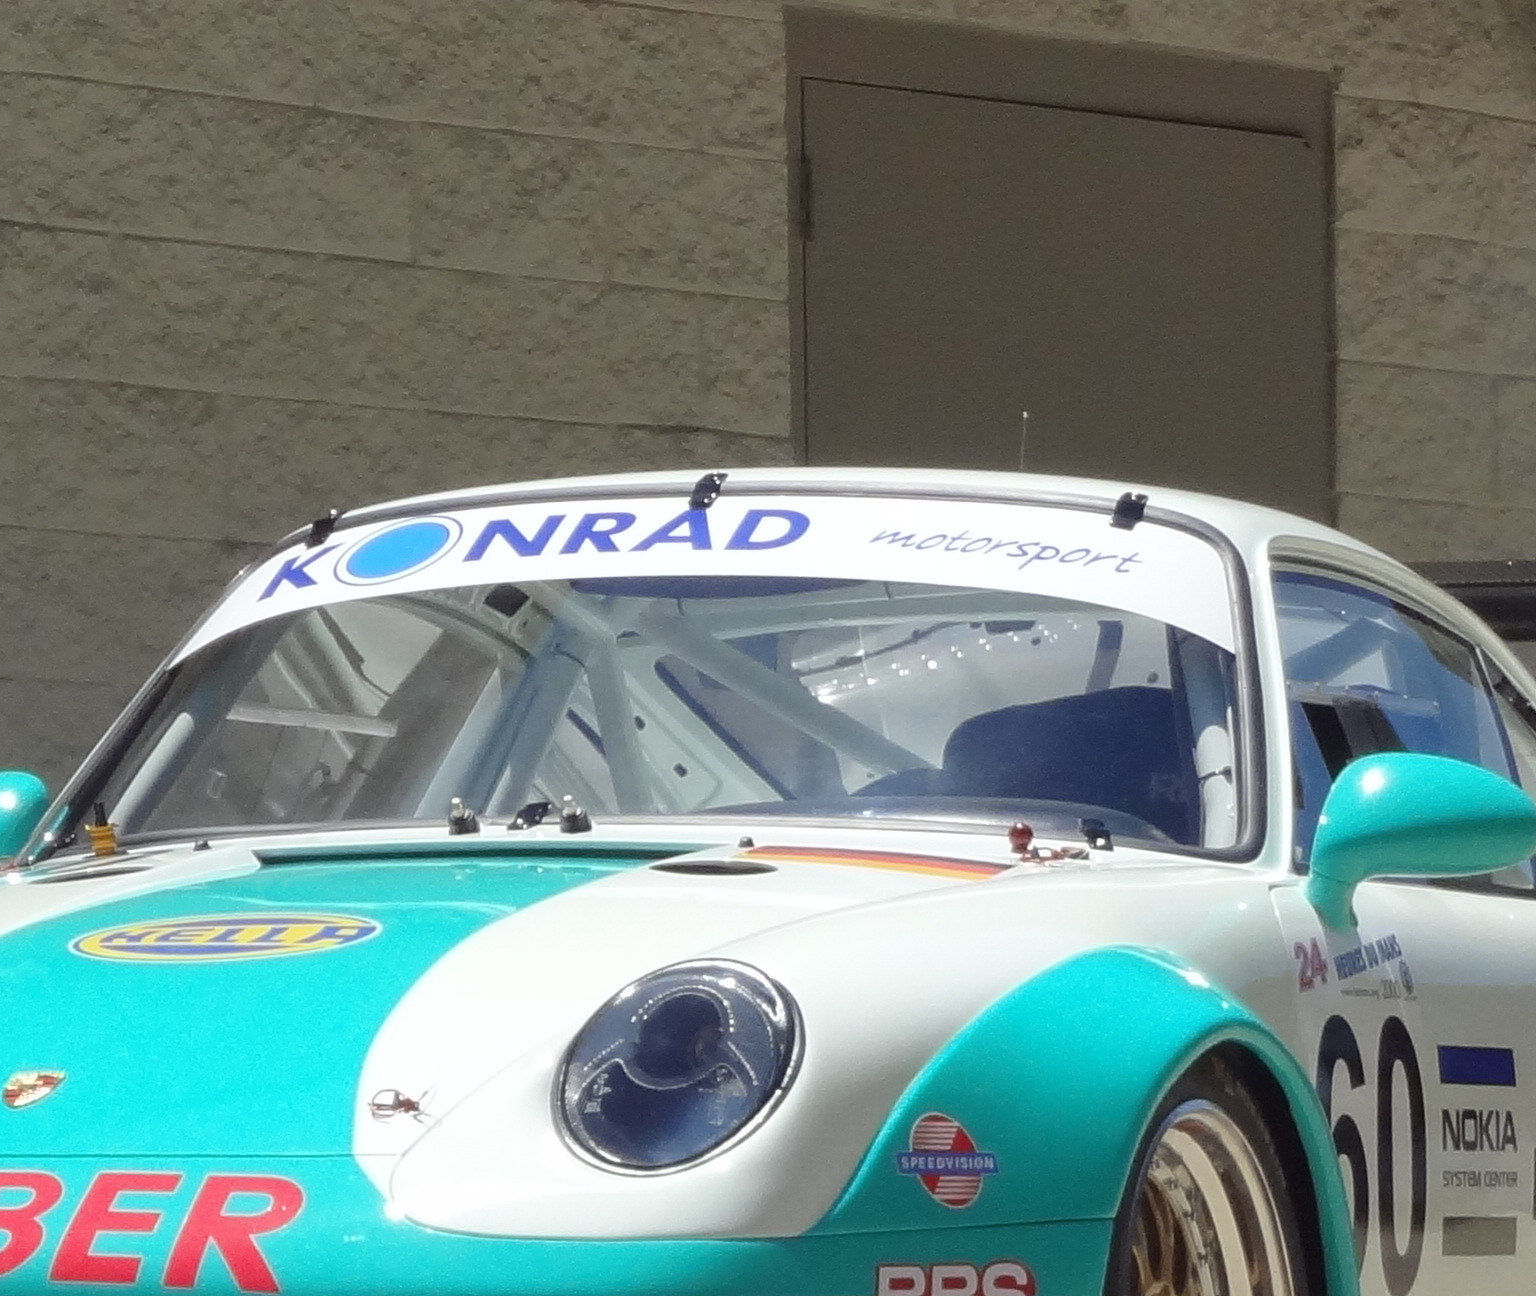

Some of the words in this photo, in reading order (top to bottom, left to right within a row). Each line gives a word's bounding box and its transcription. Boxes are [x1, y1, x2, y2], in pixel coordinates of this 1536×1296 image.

[869, 529, 1144, 573] motorsport
[100, 925, 379, 946] HELLA
[1441, 1108, 1518, 1153] NOKIA
[900, 1156, 995, 1170] SPEEDVISION
[1442, 1170, 1482, 1188] SYSTEM
[1484, 1170, 1519, 1189] CENTER
